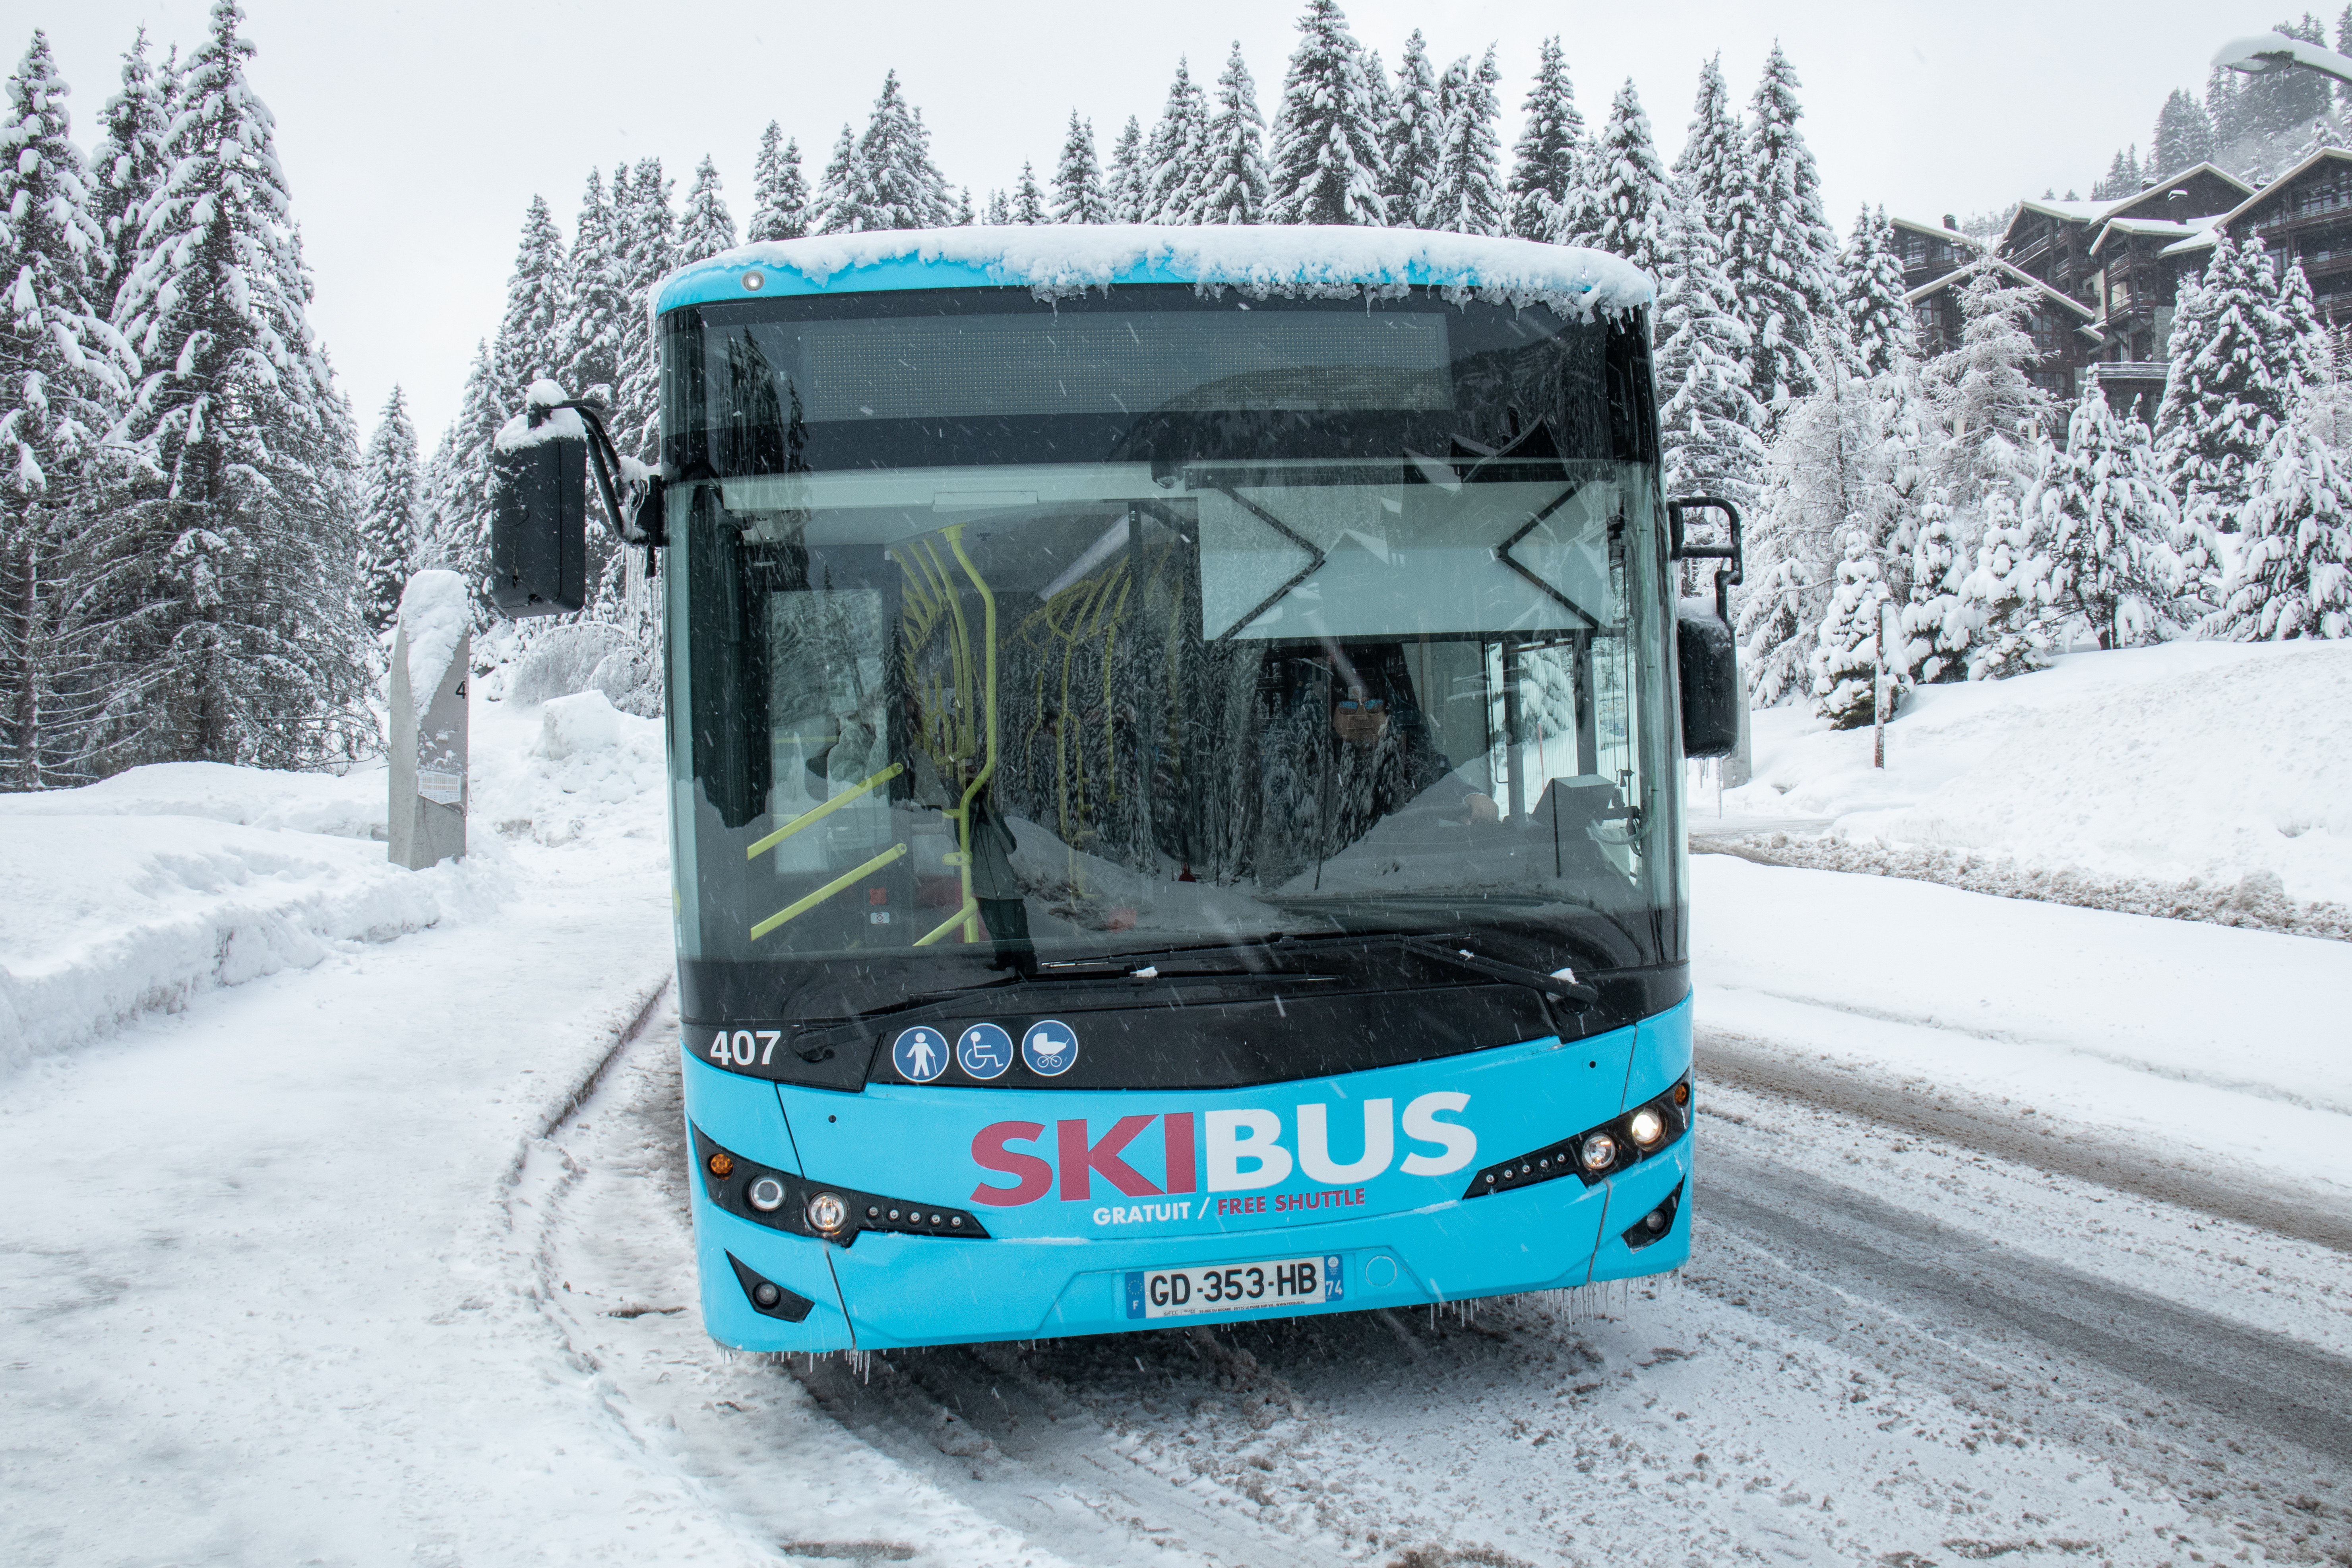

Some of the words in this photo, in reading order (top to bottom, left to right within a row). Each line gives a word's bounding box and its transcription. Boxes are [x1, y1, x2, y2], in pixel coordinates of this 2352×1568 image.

[455, 680, 466, 699] 4
[710, 1030, 781, 1065] 407
[969, 1091, 1477, 1207] SKIBUS
[1093, 1202, 1191, 1225] GRATUIT
[1197, 1197, 1210, 1219] /
[1217, 1196, 1267, 1215] FREE
[1275, 1188, 1365, 1212] SHUTTLE
[1150, 1262, 1317, 1306] GD-353-HB
[1326, 1279, 1343, 1295] 74
[1133, 1300, 1139, 1310] F
